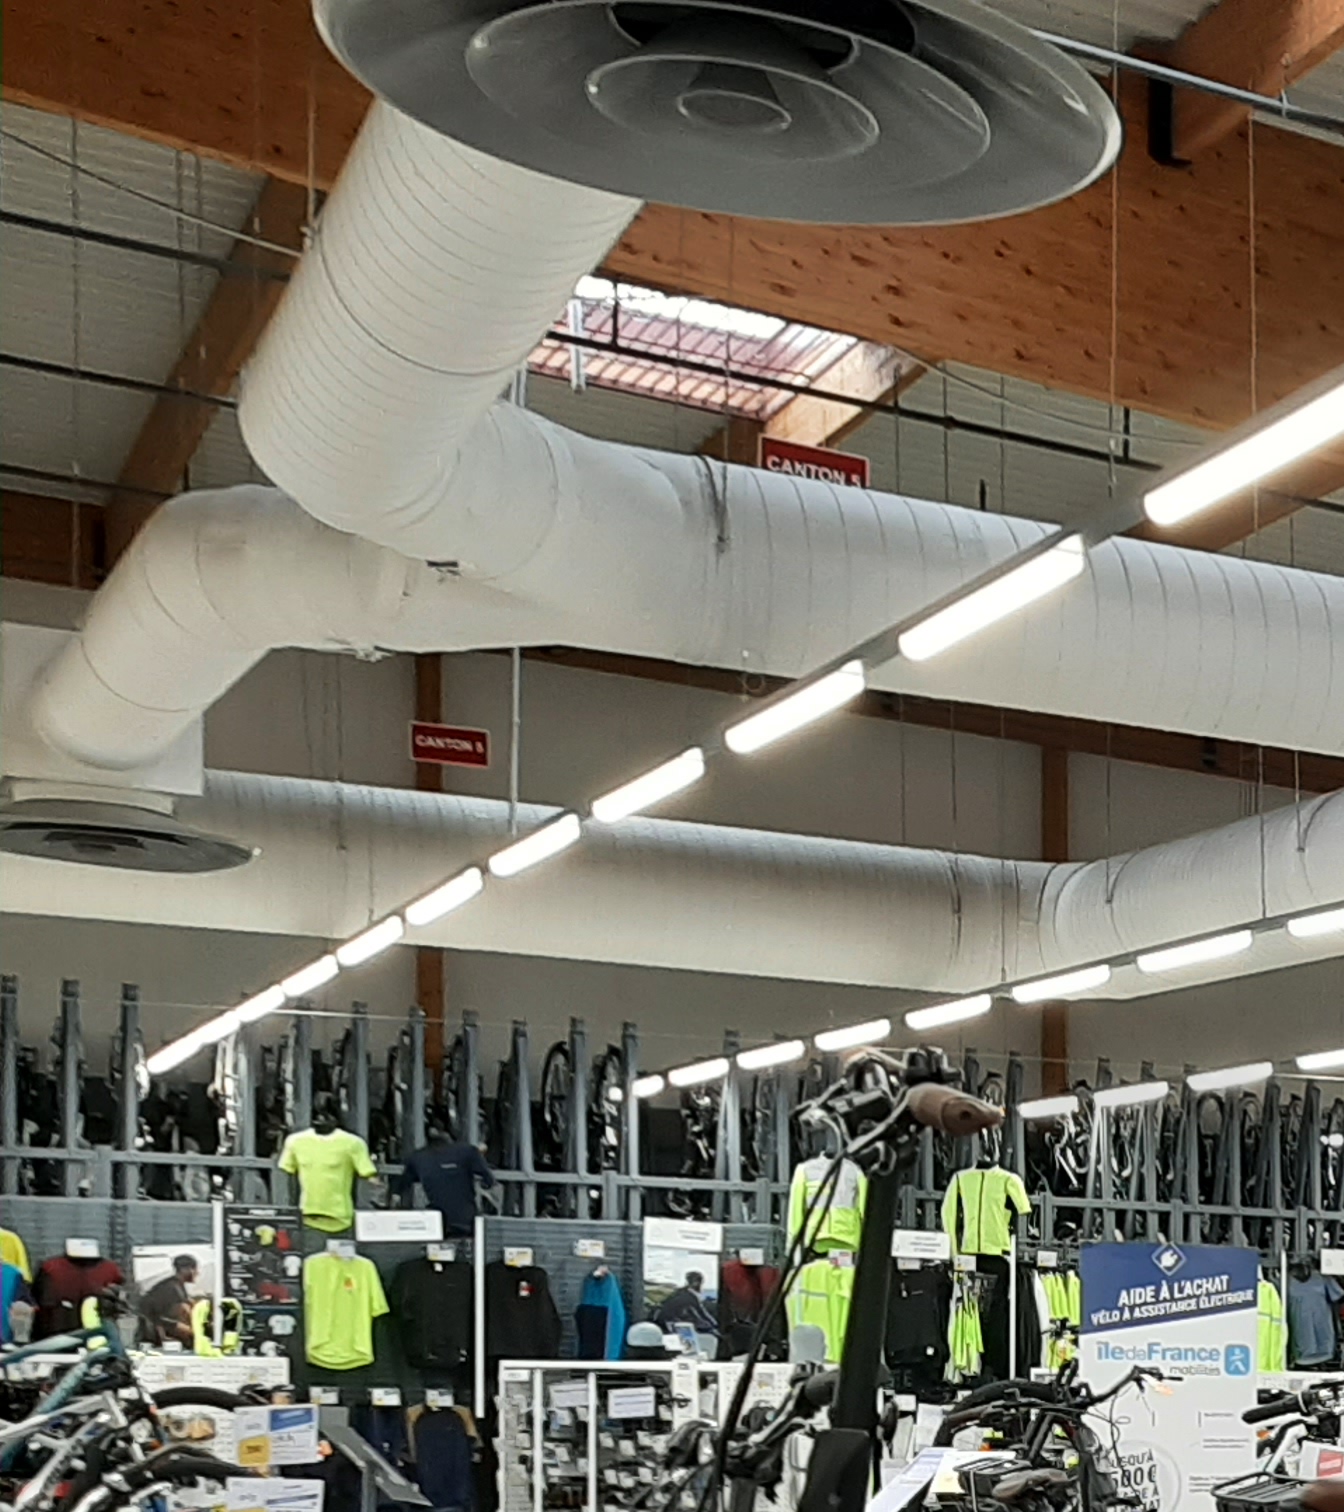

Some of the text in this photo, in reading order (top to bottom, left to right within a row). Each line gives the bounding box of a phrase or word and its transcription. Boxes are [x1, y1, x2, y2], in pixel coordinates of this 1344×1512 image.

[766, 455, 846, 486] CANTON
[1117, 1274, 1230, 1308] AIDE À L'ACHAT
[1091, 1305, 1120, 1326] VÉLO
[1133, 1298, 1197, 1318] ASSISTANCE
